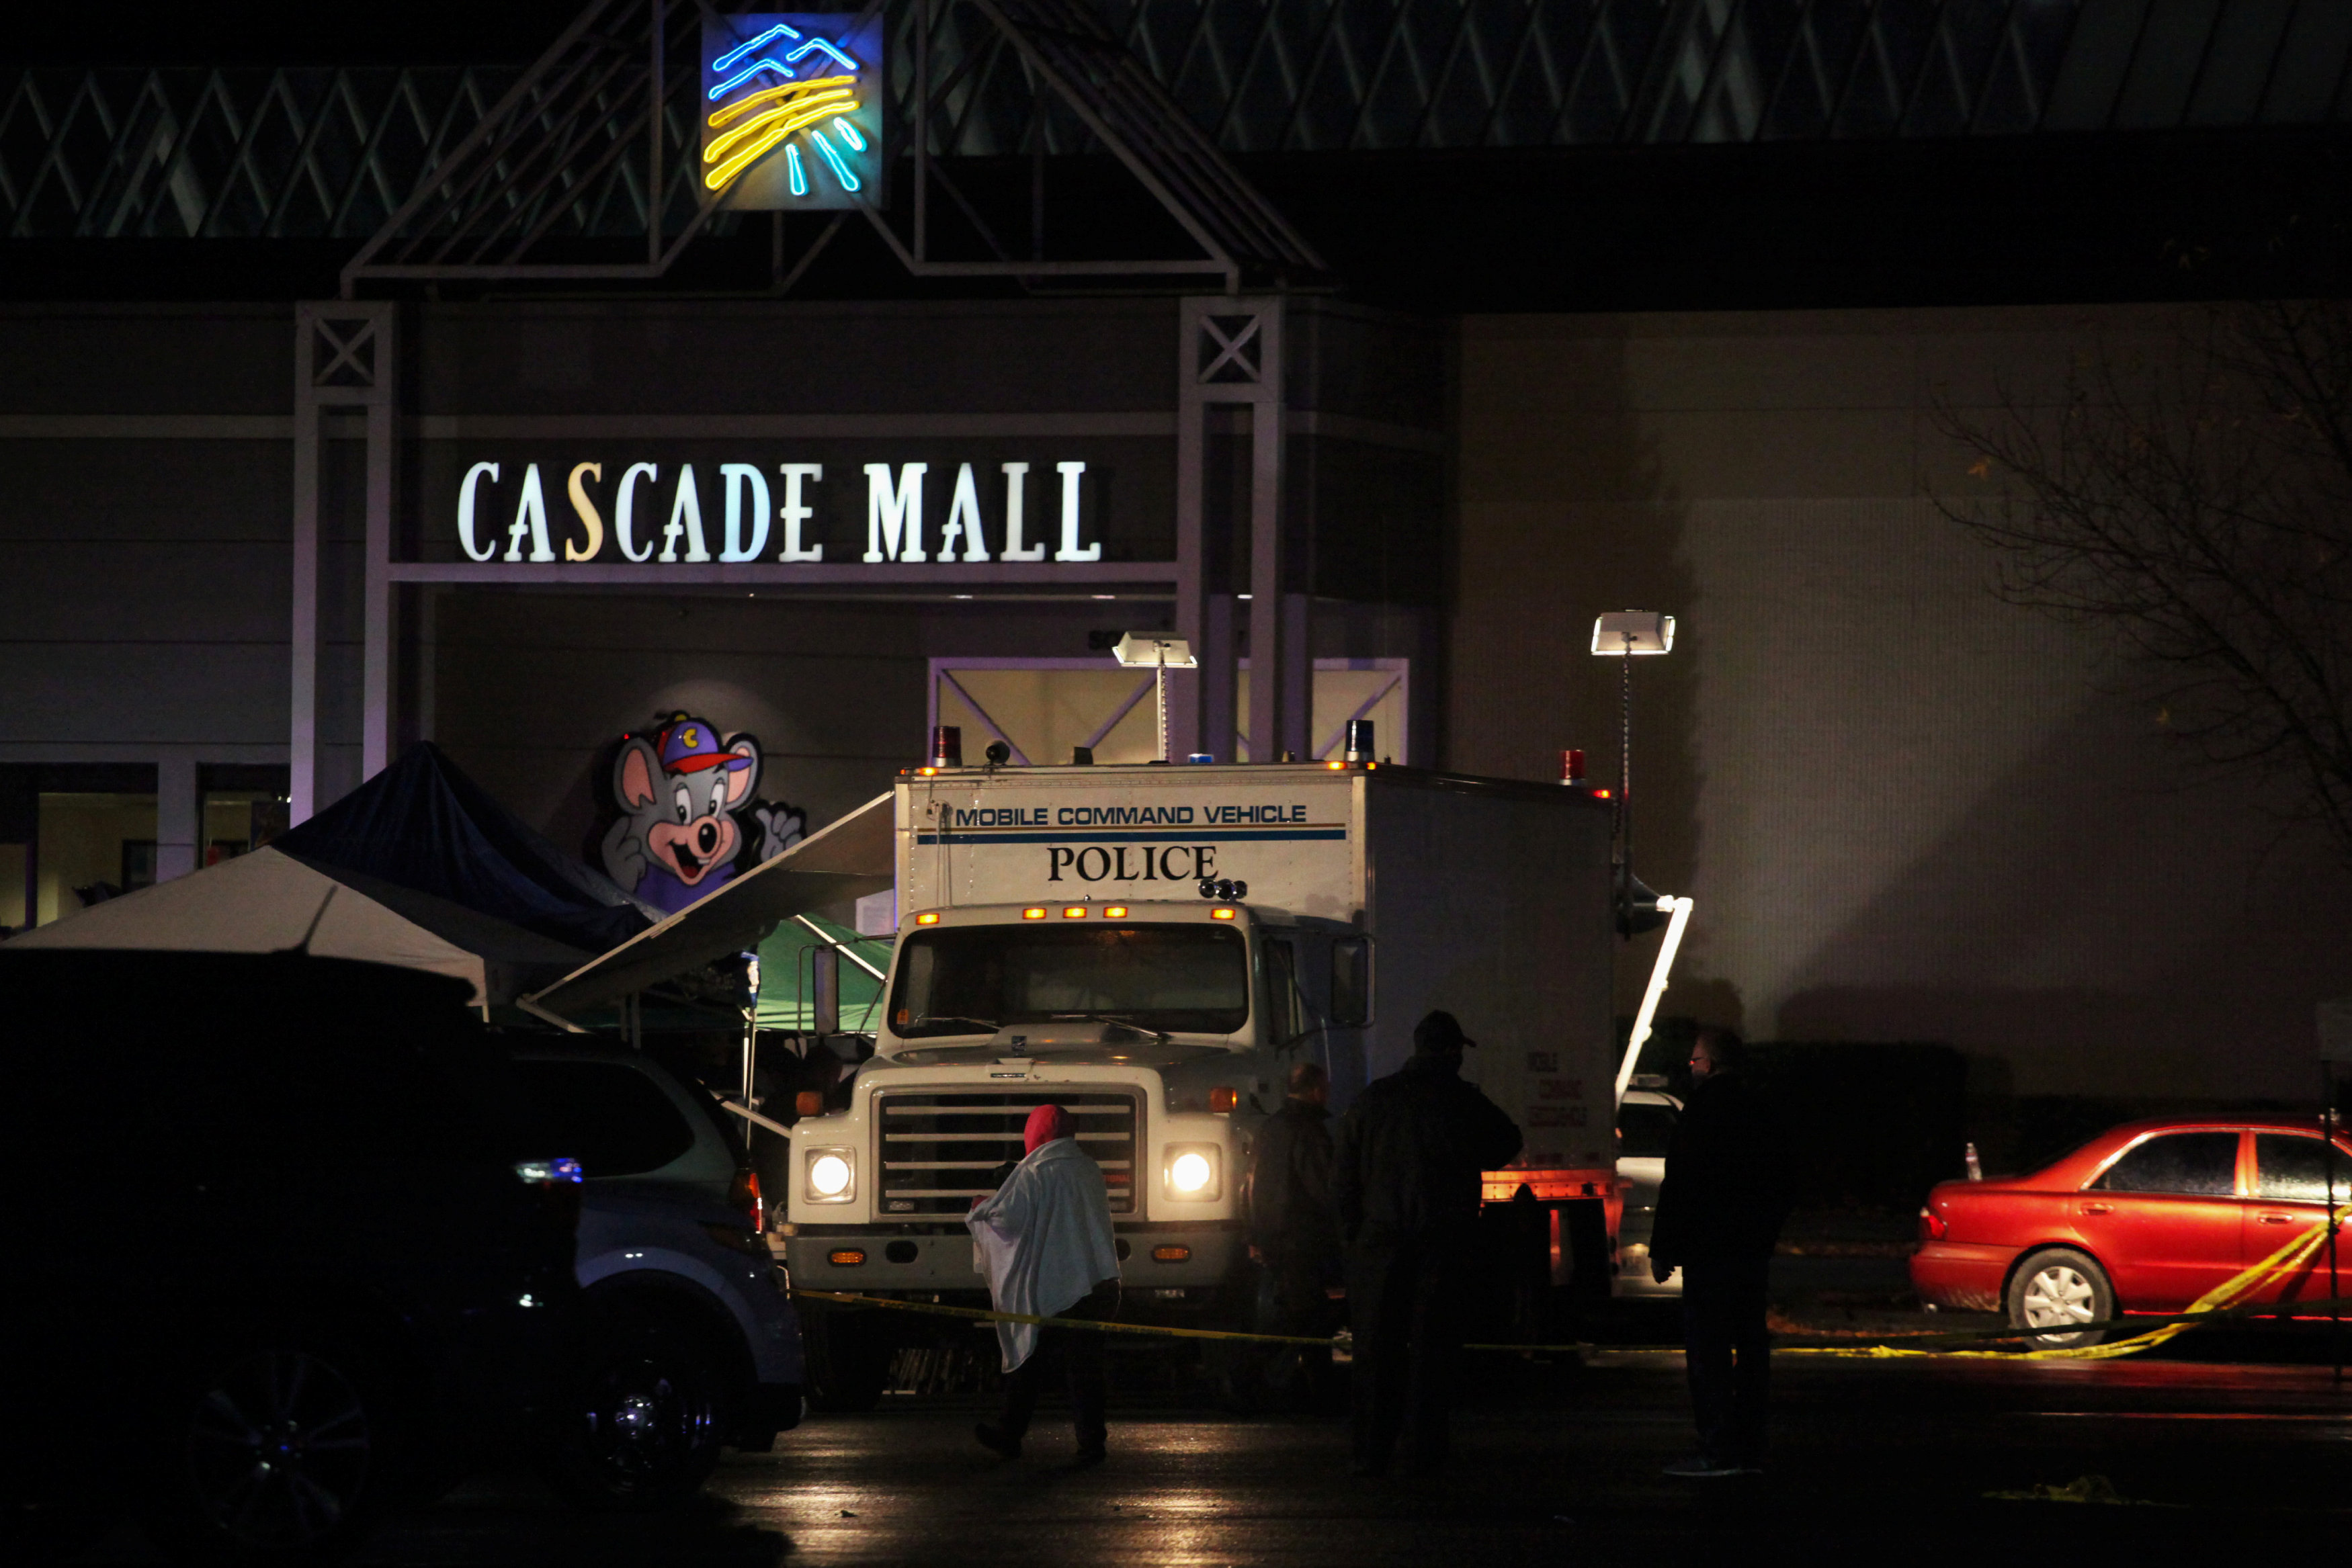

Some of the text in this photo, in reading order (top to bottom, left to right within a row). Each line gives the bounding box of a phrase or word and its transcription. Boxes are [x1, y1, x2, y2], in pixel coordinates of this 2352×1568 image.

[458, 462, 1101, 563] CASCADE MALL
[956, 805, 1306, 826] MOBILE COMMAND VEHICLE
[1048, 845, 1219, 881] POLICE
